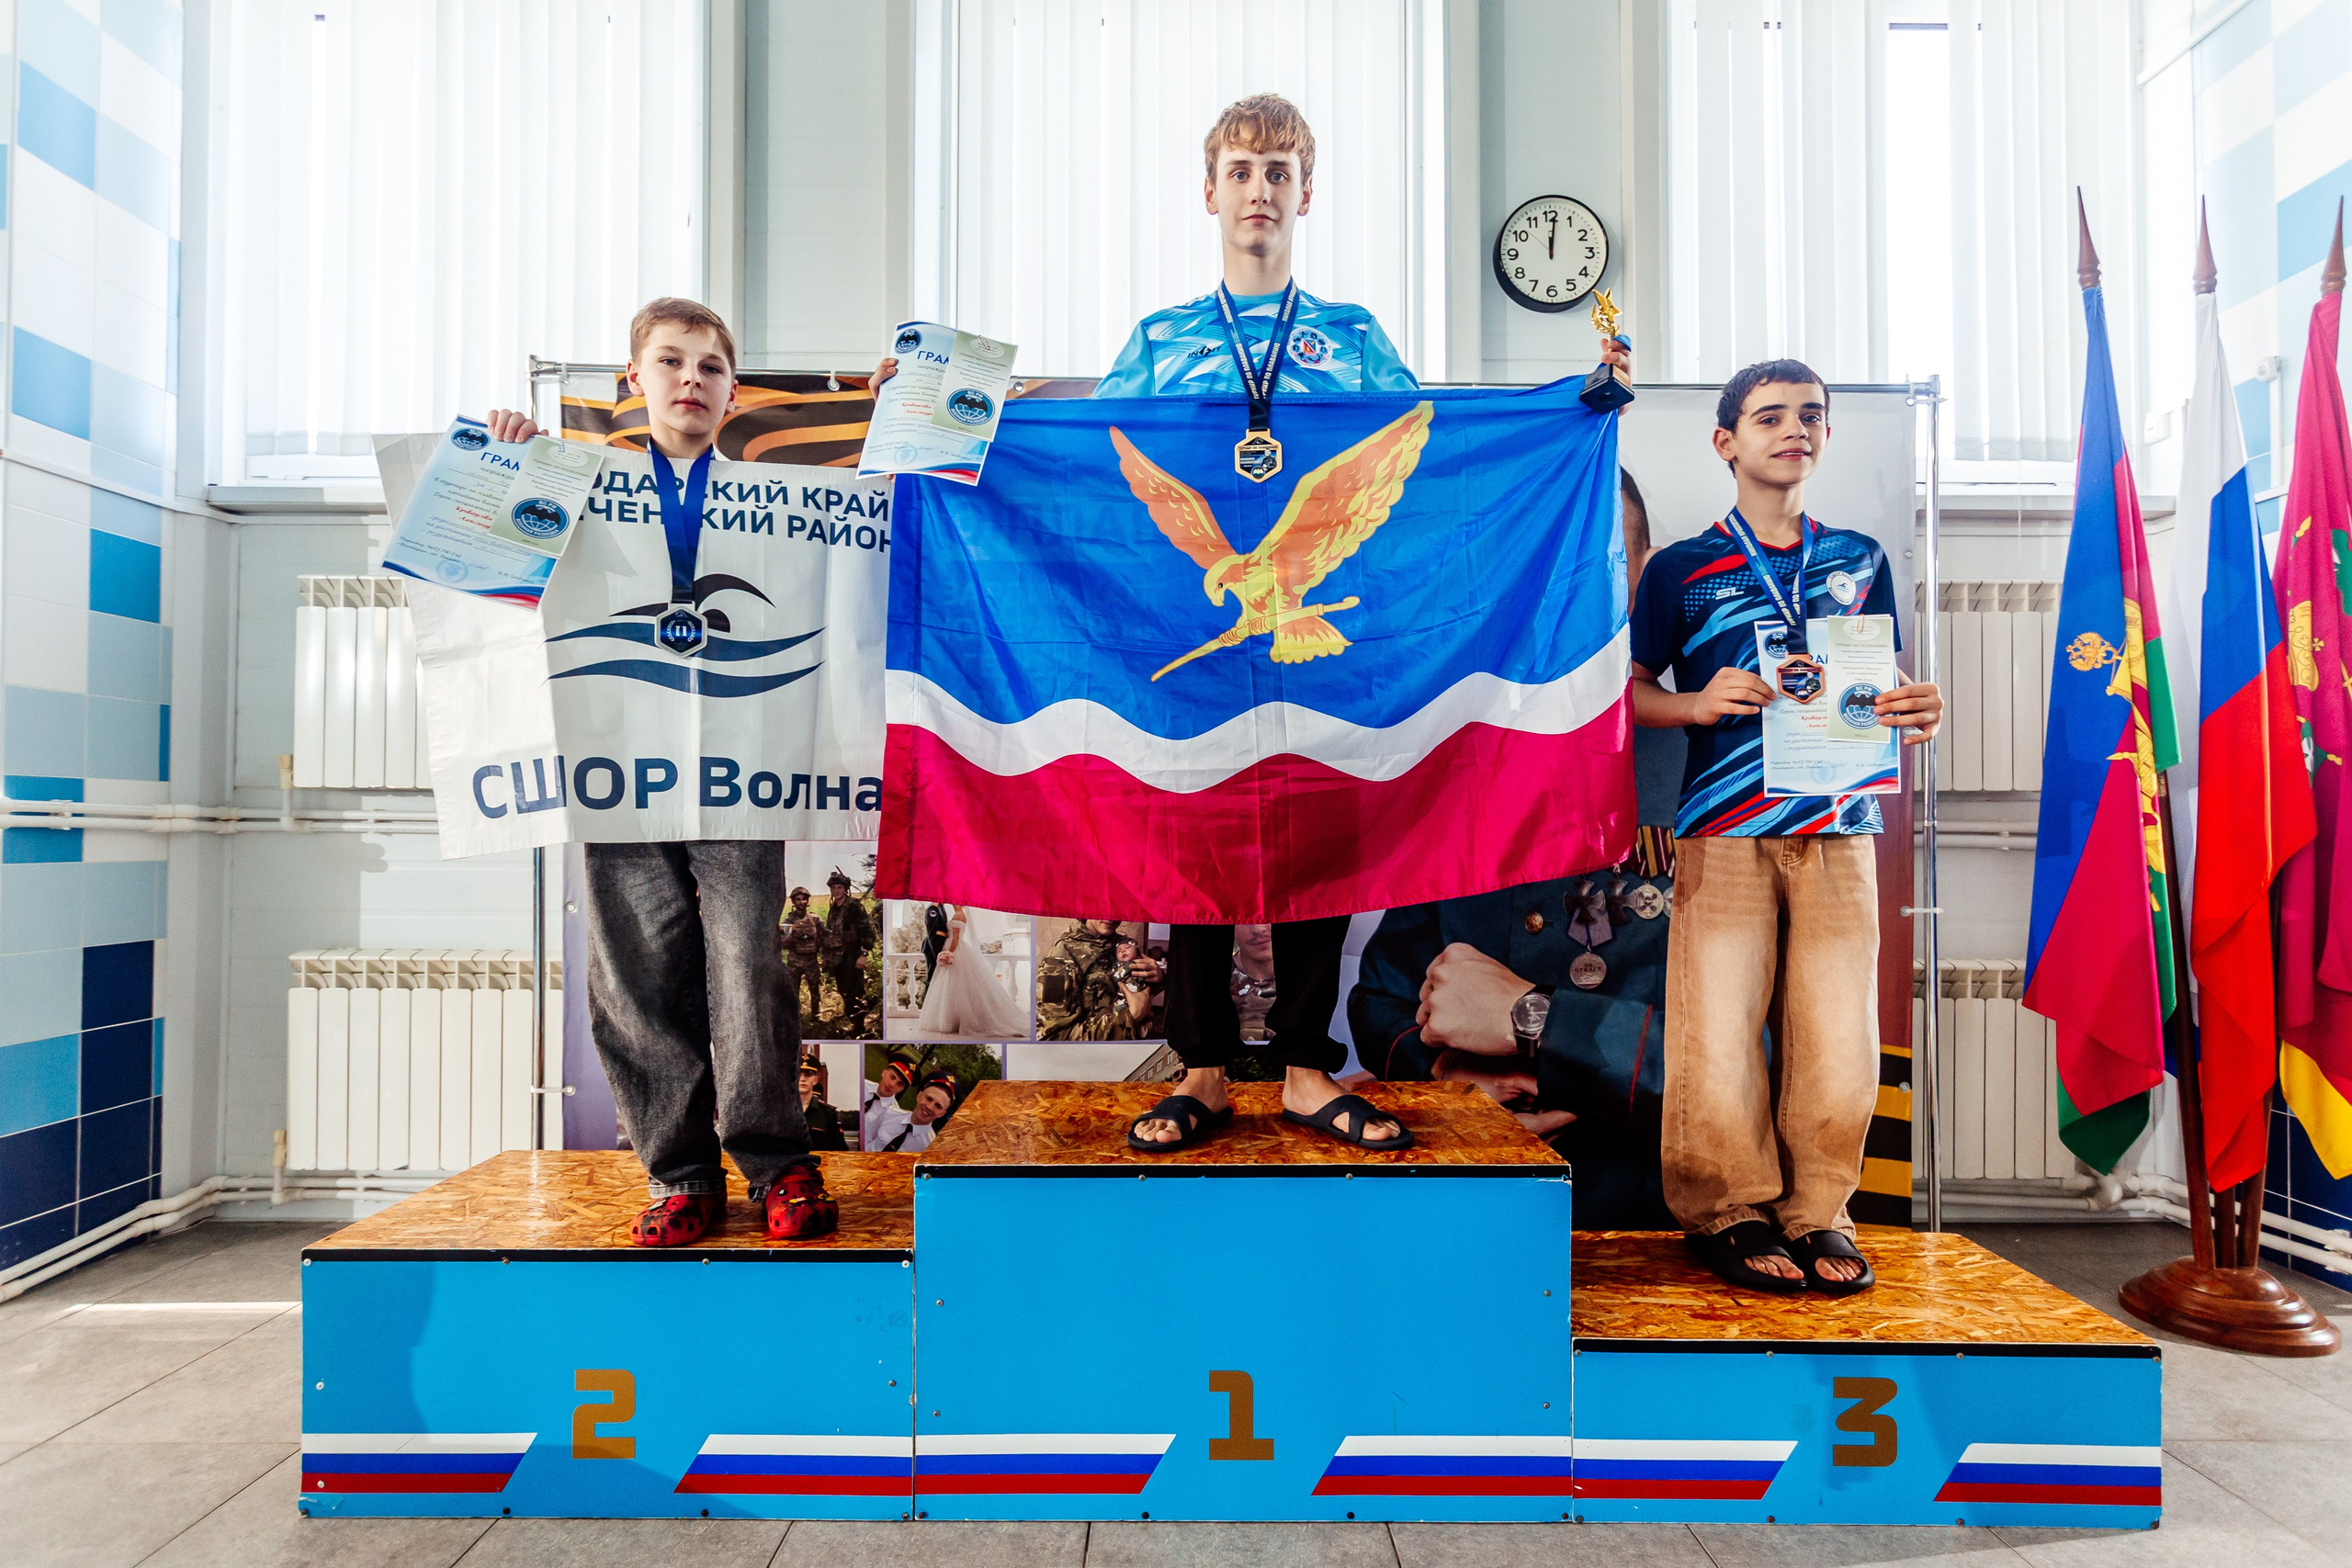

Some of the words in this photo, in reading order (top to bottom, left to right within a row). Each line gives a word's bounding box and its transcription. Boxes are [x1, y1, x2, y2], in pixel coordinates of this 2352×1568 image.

[1526, 216, 1538, 229] 11
[1543, 210, 1558, 223] 12
[1566, 216, 1573, 228] 1
[1512, 230, 1529, 243] 10
[1577, 230, 1589, 242] 2
[1507, 248, 1519, 261] 9
[1585, 247, 1595, 259] 3
[1514, 266, 1525, 279] 8
[1578, 265, 1589, 277] 4
[1529, 279, 1539, 292] 7
[1546, 285, 1558, 298] 6
[1566, 279, 1577, 291] 5
[802, 486, 888, 522] КРАЙ
[579, 497, 774, 536] ЧЕНКИЙ
[787, 514, 891, 553] РАЙОН
[1715, 586, 1745, 600] SL
[675, 626, 687, 637] II
[473, 755, 679, 818] СШОР
[699, 756, 882, 812] Волна
[572, 1369, 635, 1460] 2
[1209, 1371, 1274, 1461] 1
[1833, 1377, 1898, 1467] 3
